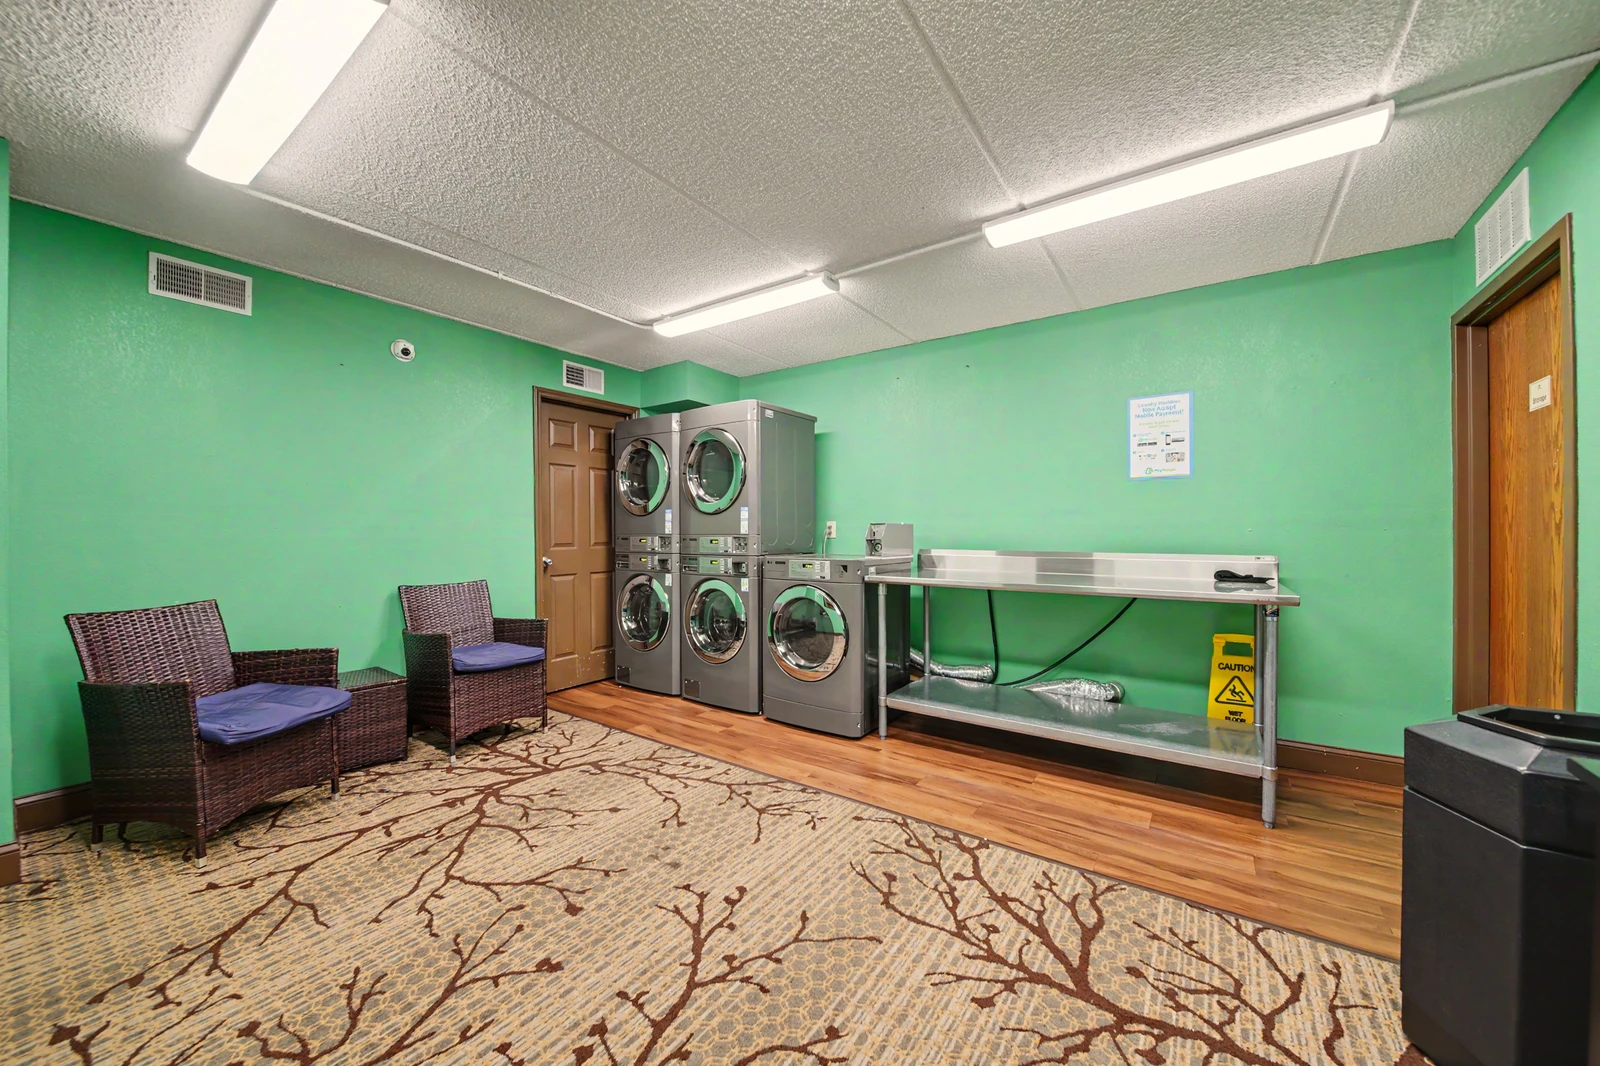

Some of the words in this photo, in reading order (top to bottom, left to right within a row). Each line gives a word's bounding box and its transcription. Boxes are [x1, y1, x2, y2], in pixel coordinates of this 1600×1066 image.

[1155, 409, 1184, 418] Payment!
[1218, 662, 1255, 673] CAUTION
[1228, 709, 1243, 718] WET
[1225, 715, 1246, 724] FLOOR
